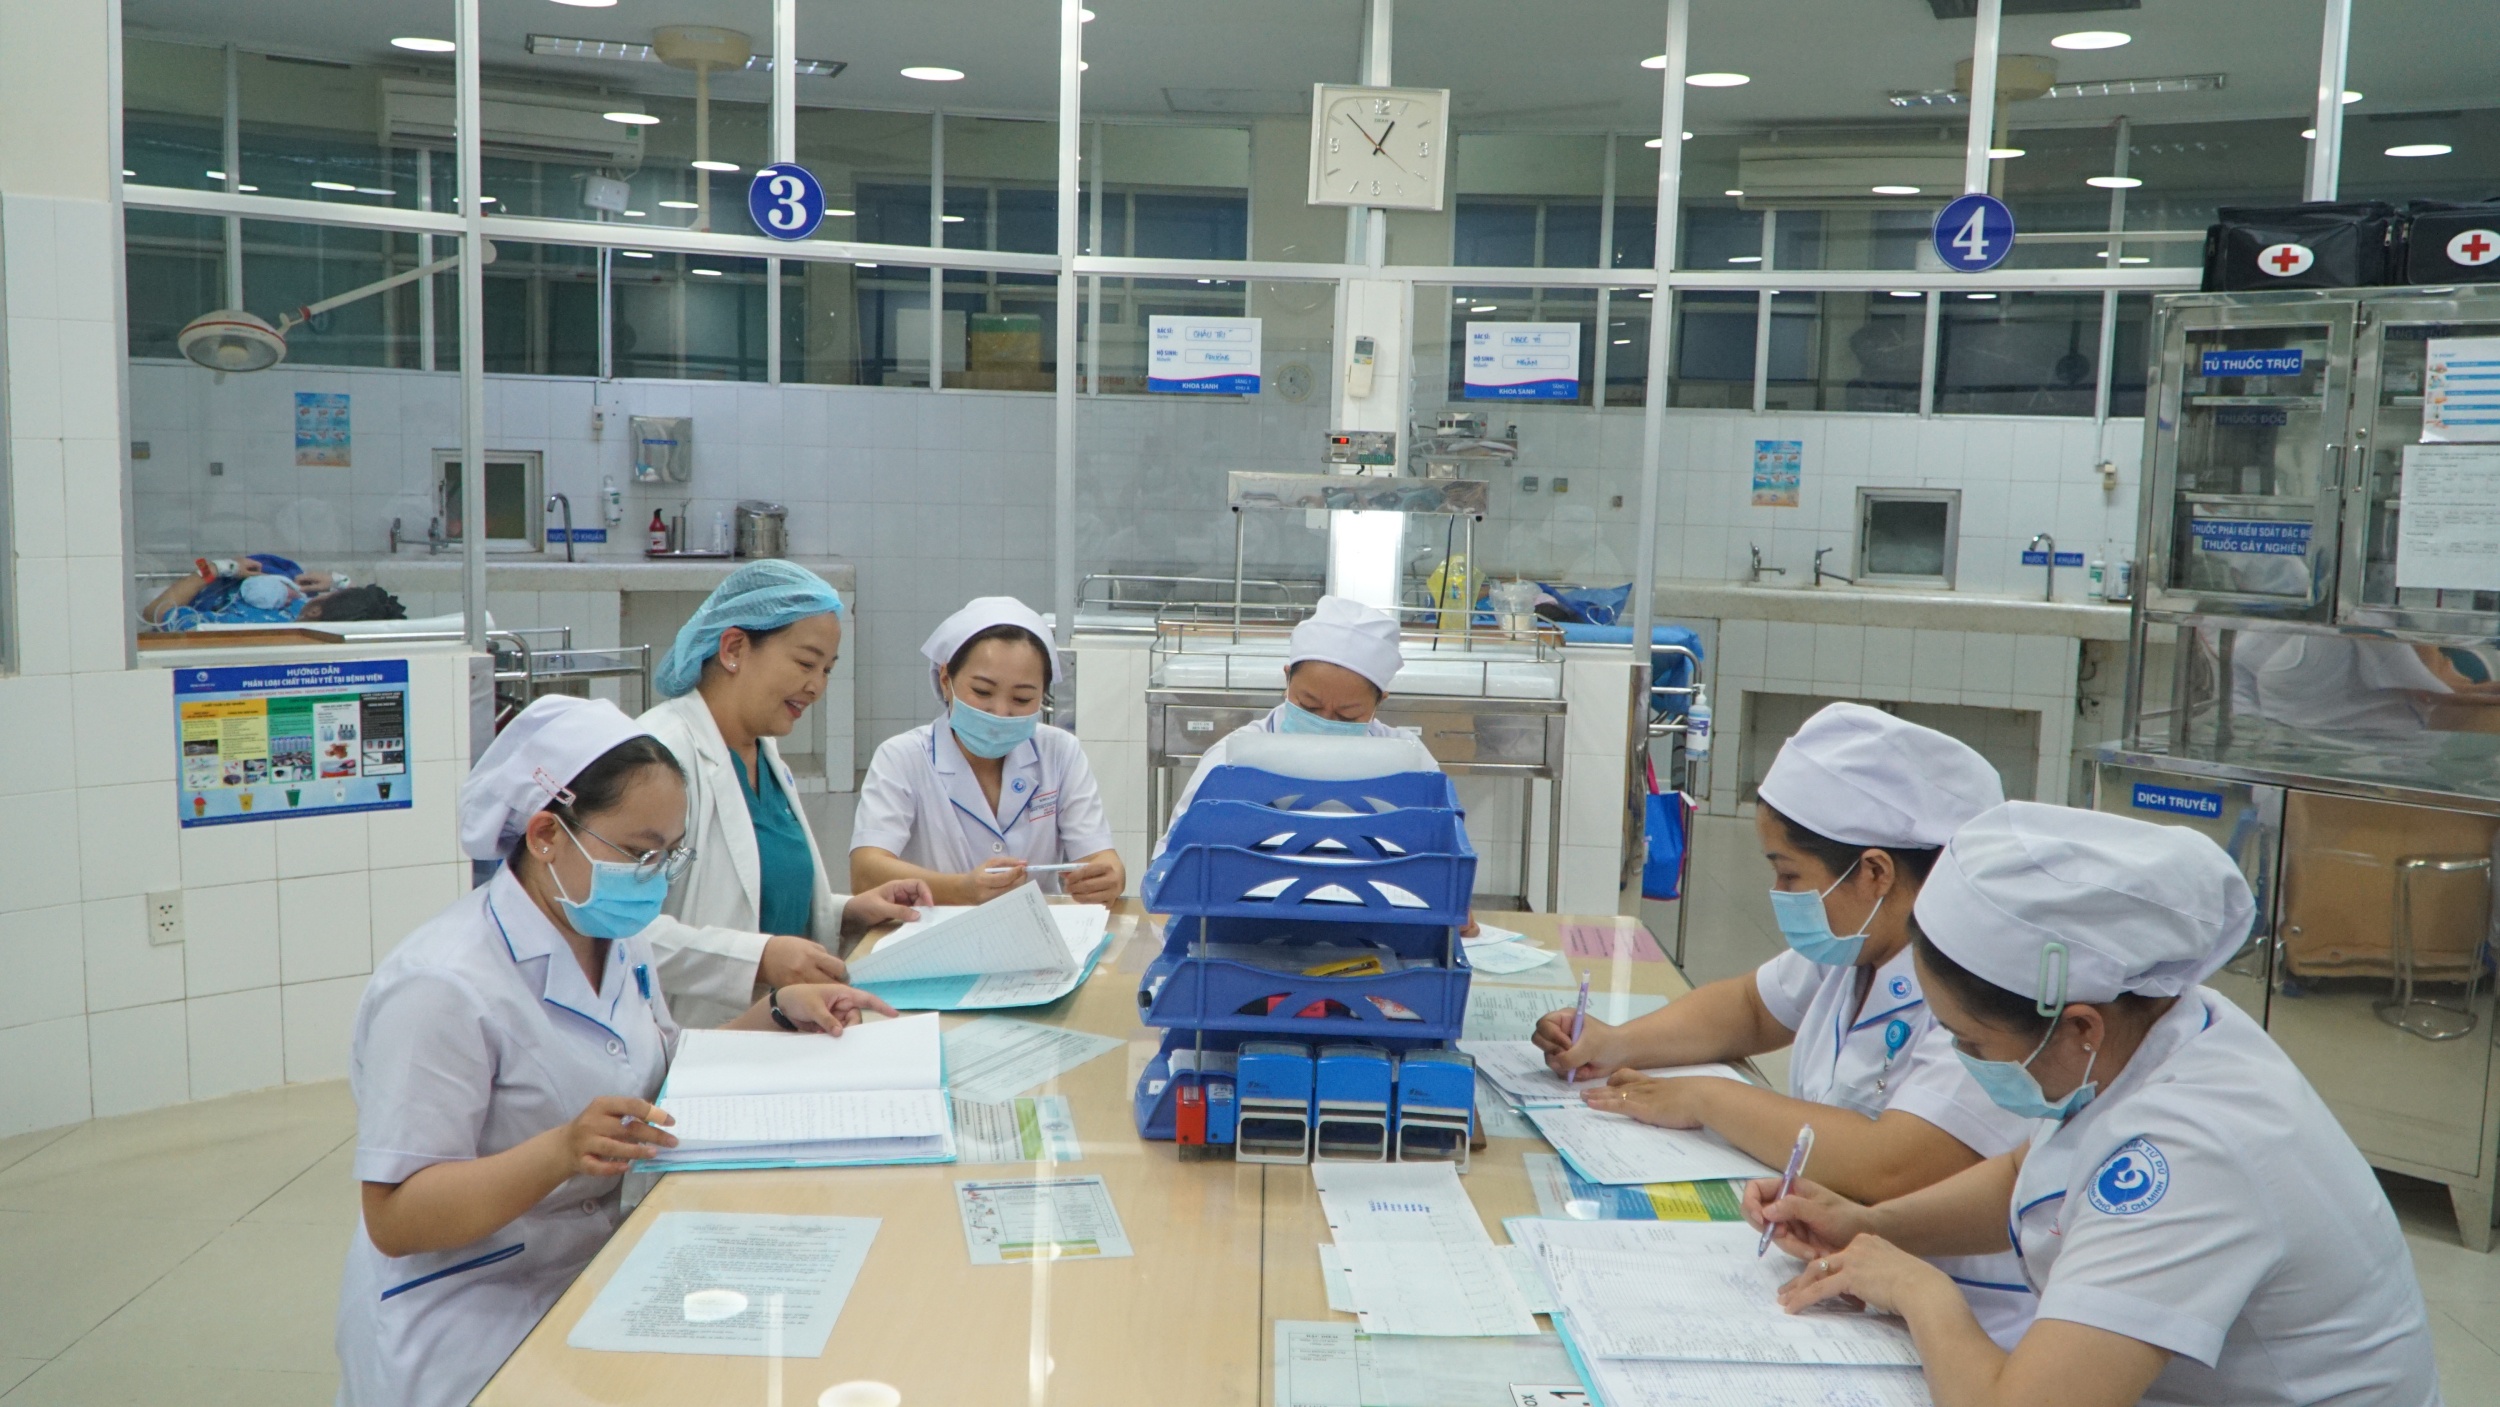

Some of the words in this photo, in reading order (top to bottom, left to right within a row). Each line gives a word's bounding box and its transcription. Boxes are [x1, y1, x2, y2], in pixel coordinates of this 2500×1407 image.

[1374, 98, 1390, 115] 12
[1329, 138, 1340, 153] 9
[1419, 142, 1429, 158] 3
[1370, 180, 1381, 196] 6
[768, 175, 807, 230] 3
[1952, 206, 1989, 260] 4
[2205, 357, 2219, 370] TỦ
[2222, 356, 2263, 370] THUỐC
[2266, 357, 2299, 371] TRỰC
[2192, 522, 2216, 535] THUỐC
[2260, 524, 2279, 537] SOÁT
[2204, 537, 2238, 550] THUỐC
[2240, 539, 2262, 552] GÂY
[287, 667, 320, 677] HƯỚNG
[242, 679, 264, 688] PHÂN
[2137, 791, 2166, 805] DỊCH
[2147, 1181, 2164, 1203] MINH
